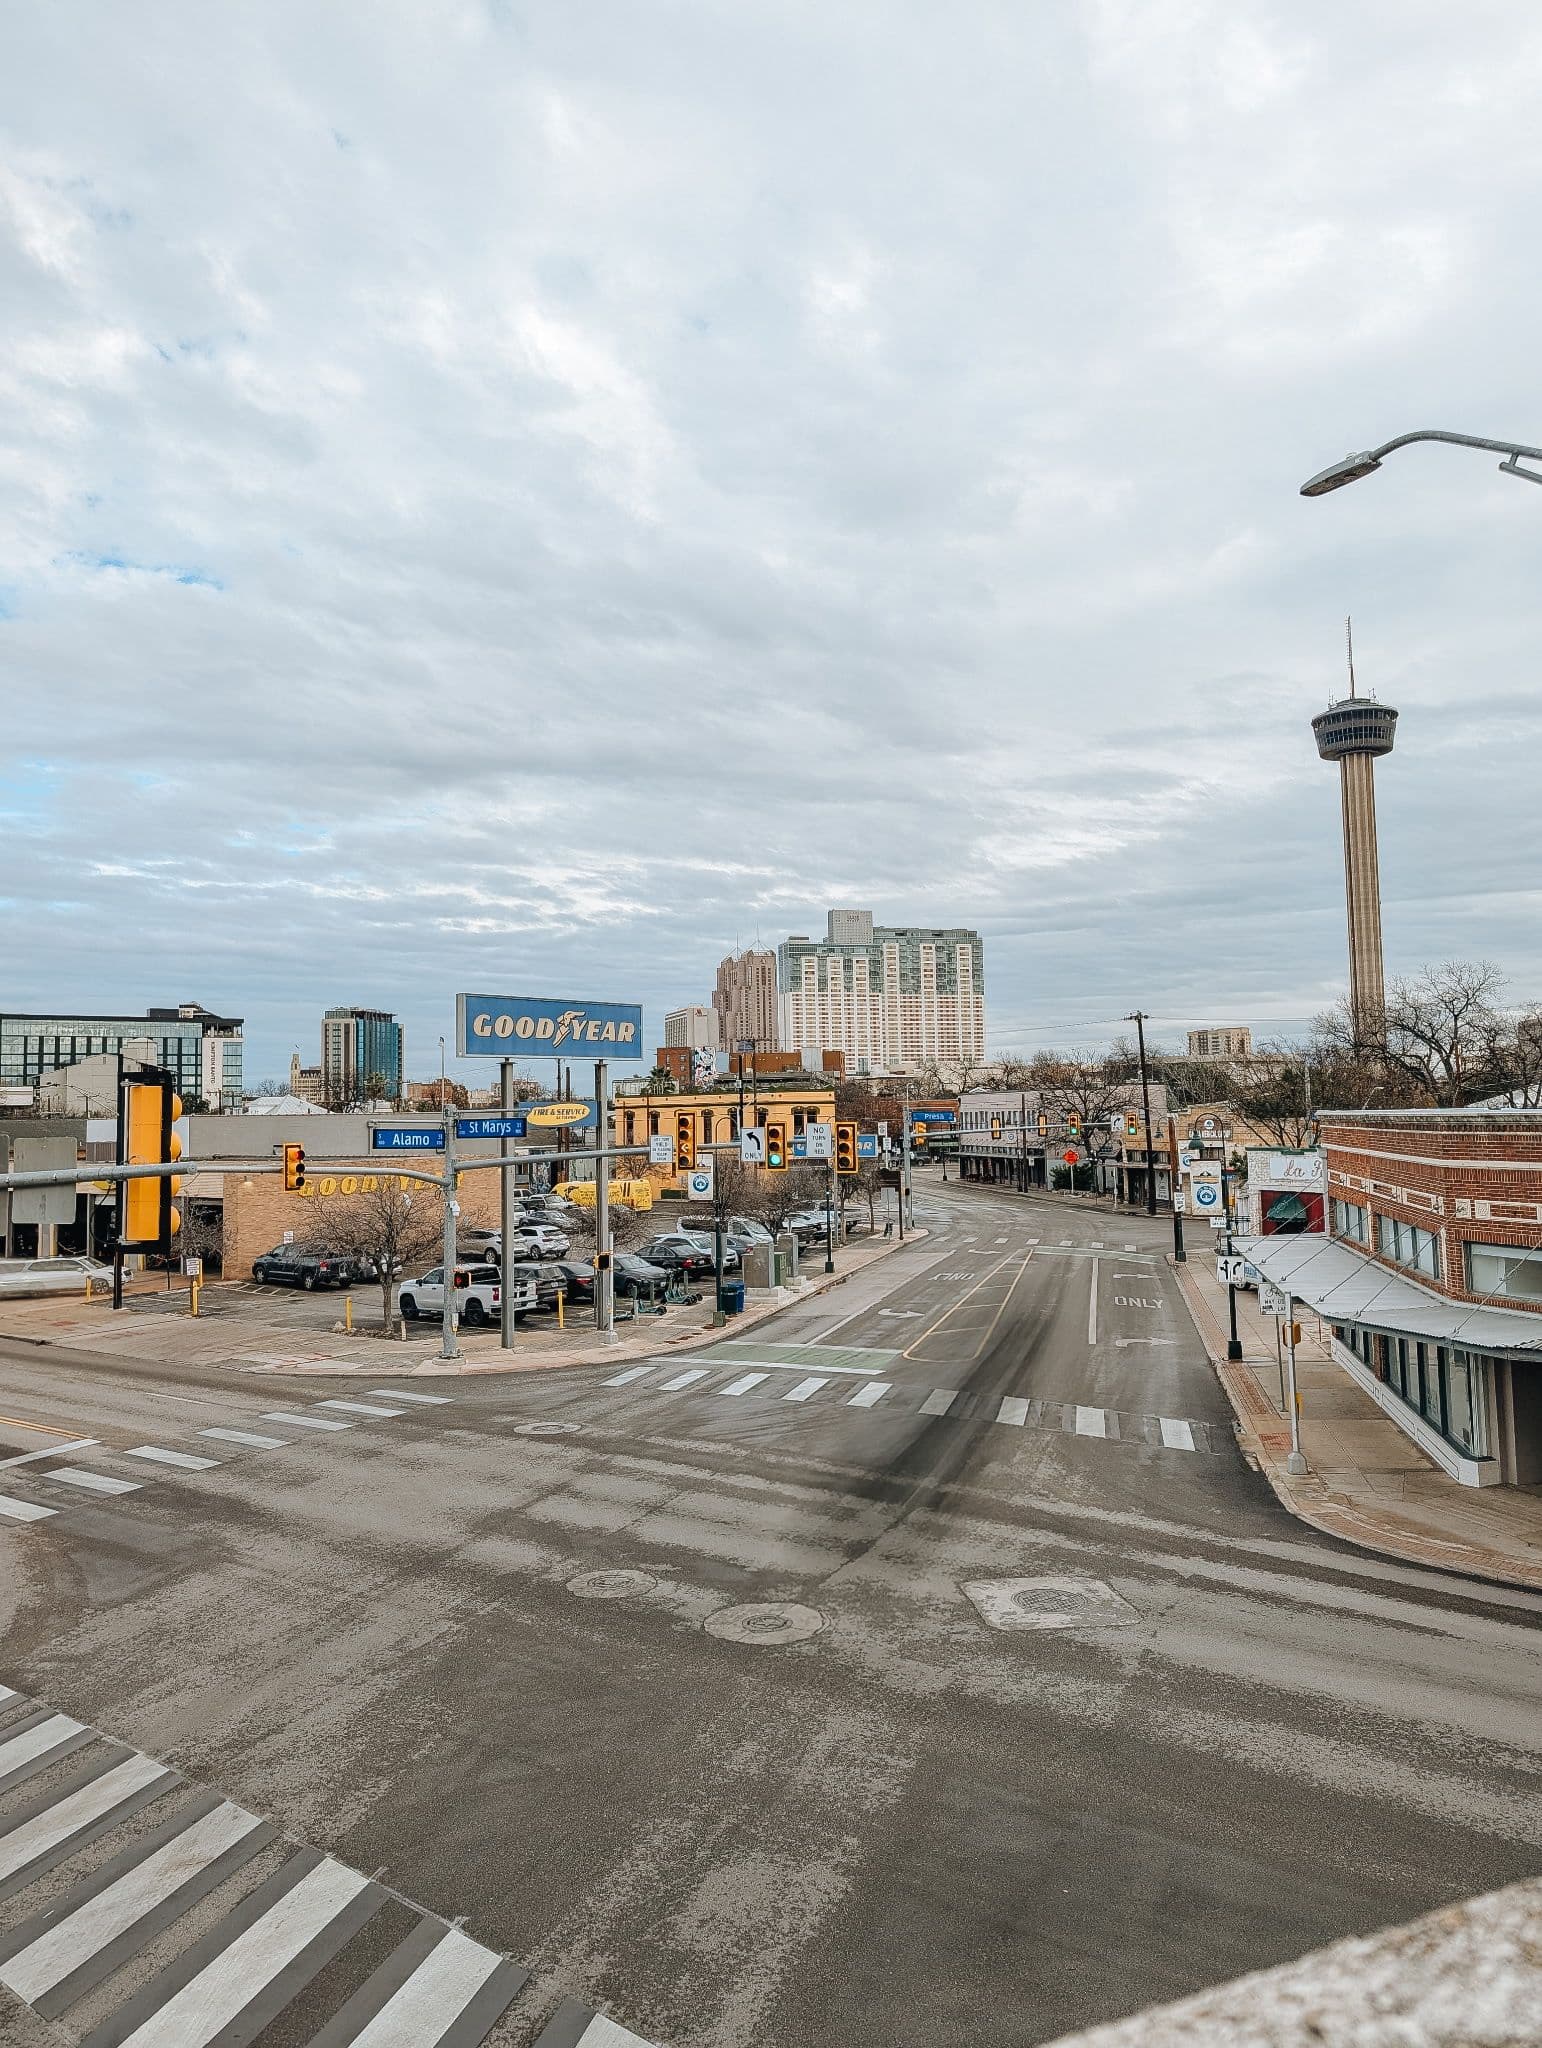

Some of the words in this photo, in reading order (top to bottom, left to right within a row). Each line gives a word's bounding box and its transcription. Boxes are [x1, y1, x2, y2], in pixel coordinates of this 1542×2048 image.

[473, 1013, 635, 1043] GOODYEAR
[556, 1108, 587, 1116] SERVICE
[469, 1122, 478, 1133] St
[482, 1121, 511, 1136] Marys
[814, 1126, 825, 1135] NO
[392, 1132, 430, 1146] Alamo
[745, 1152, 763, 1160] ONLY
[1114, 1296, 1164, 1309] ONLY
